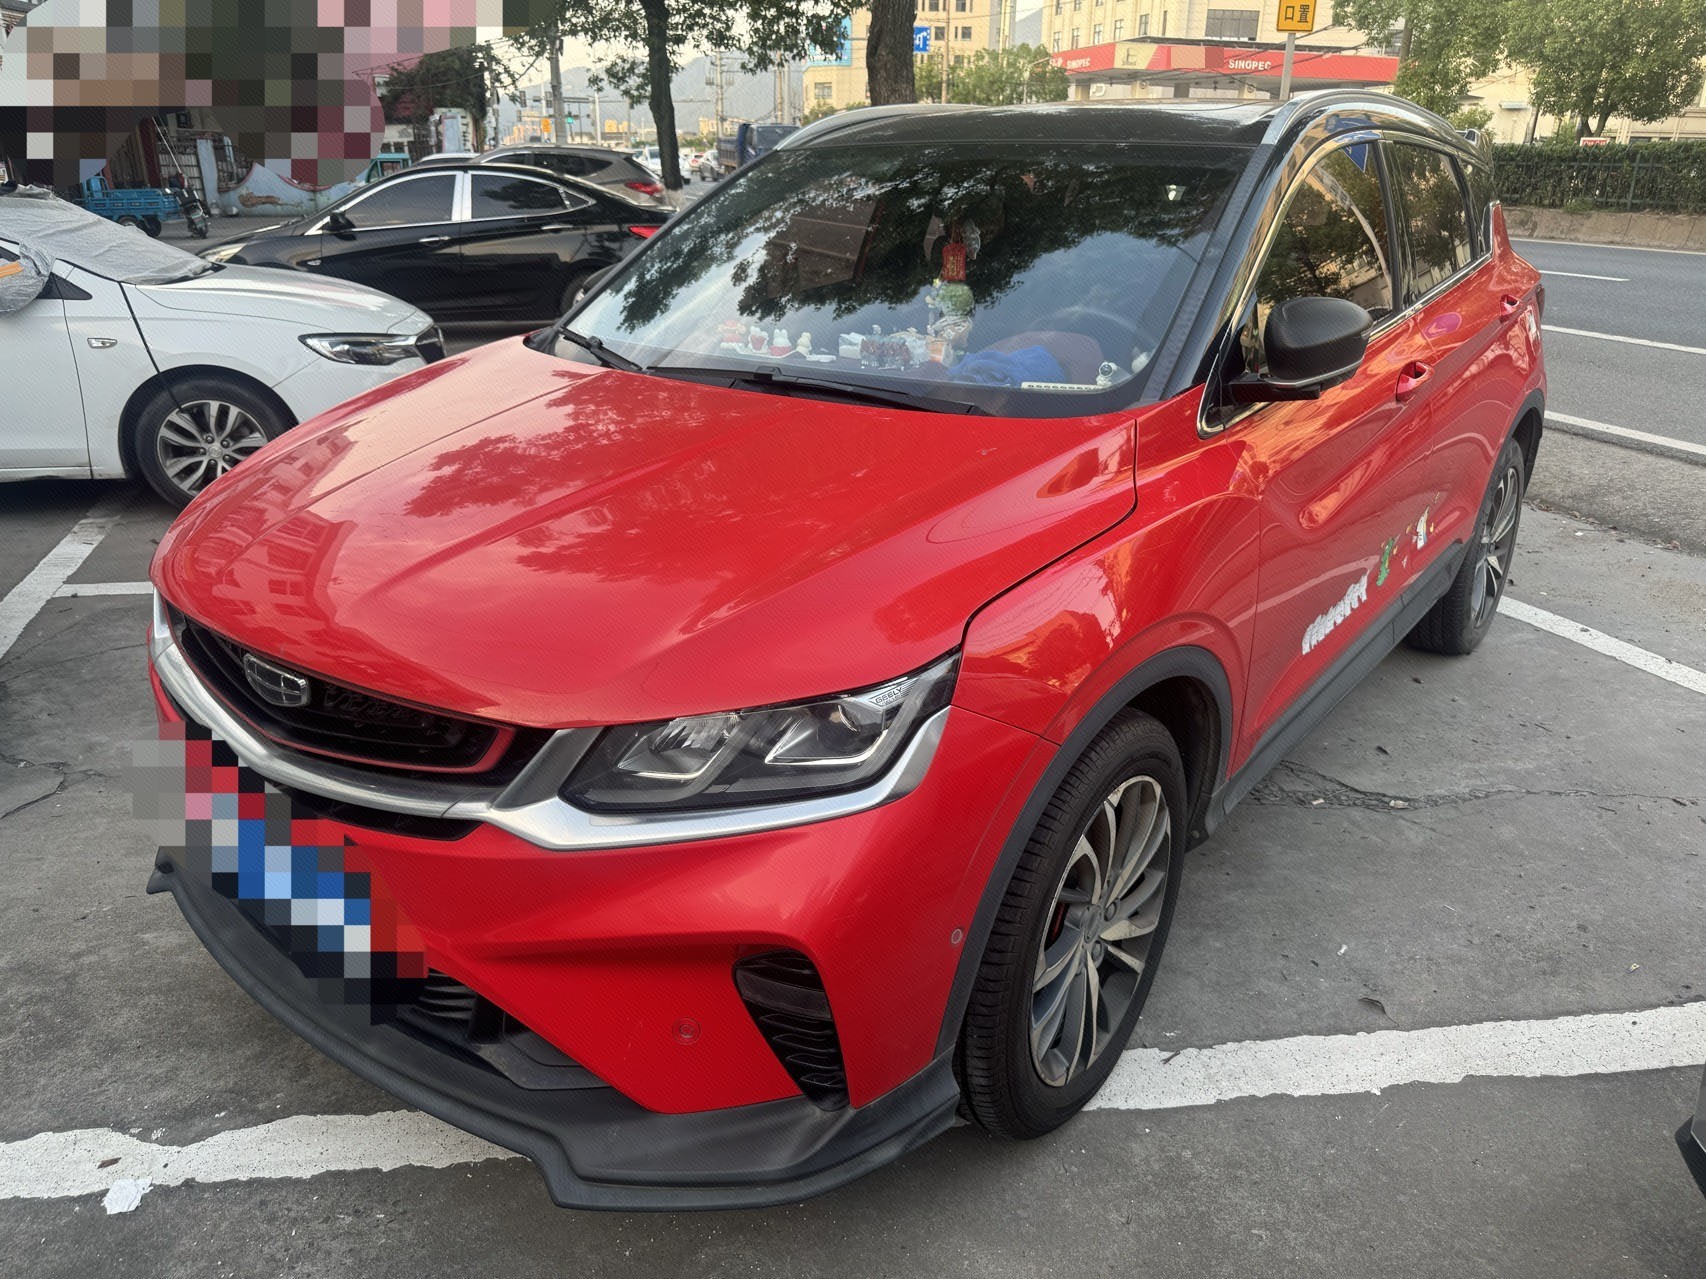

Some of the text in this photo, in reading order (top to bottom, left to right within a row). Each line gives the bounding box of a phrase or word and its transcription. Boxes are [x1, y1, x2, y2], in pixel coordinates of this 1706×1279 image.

[1284, 4, 1310, 23] 口置
[1228, 59, 1272, 71] SINOPEC
[875, 687, 902, 703] GEELY
